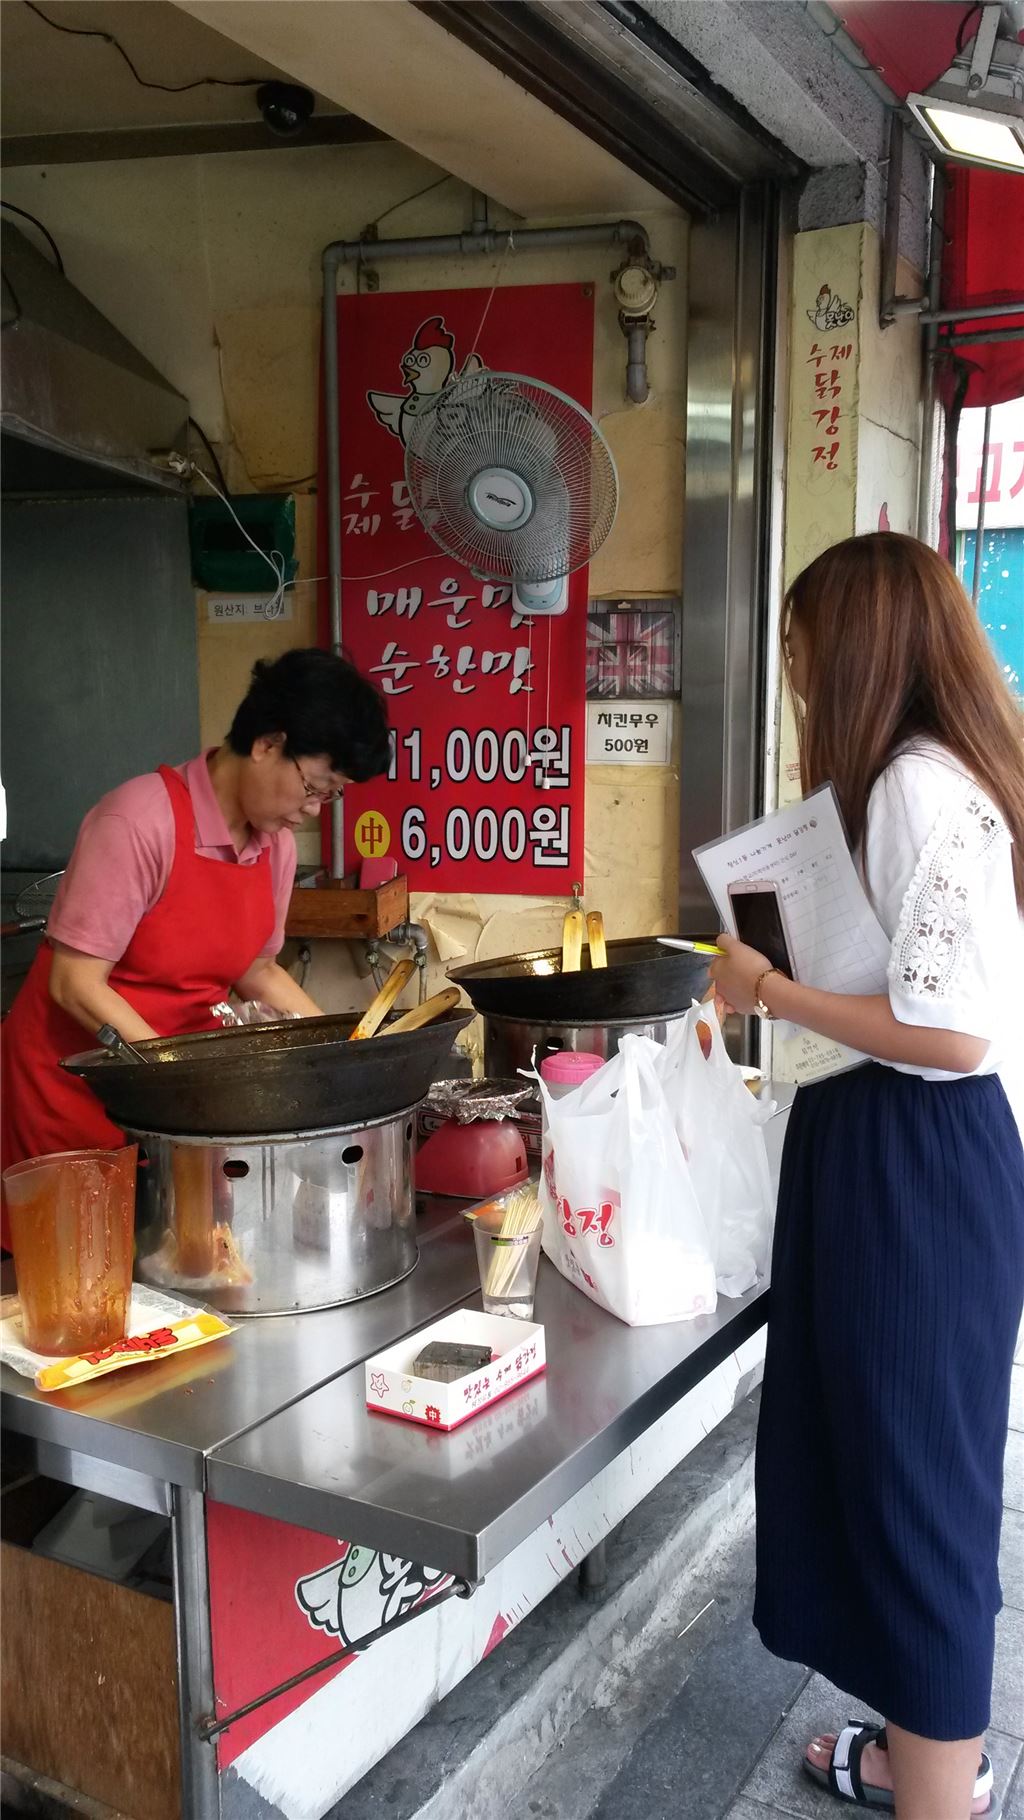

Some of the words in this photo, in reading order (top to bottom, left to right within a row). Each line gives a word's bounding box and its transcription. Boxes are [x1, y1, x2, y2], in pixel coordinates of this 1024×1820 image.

[807, 344, 852, 367] 수제
[343, 473, 381, 536] 수제
[214, 603, 245, 616] 원산지
[368, 641, 536, 695] 순한맛
[597, 713, 659, 728] 치킨무우
[387, 725, 571, 790] 11,000원
[604, 739, 649, 753] 500원
[360, 816, 384, 855] 中
[401, 805, 571, 868] 6,000원
[463, 1376, 490, 1403] 맛있는
